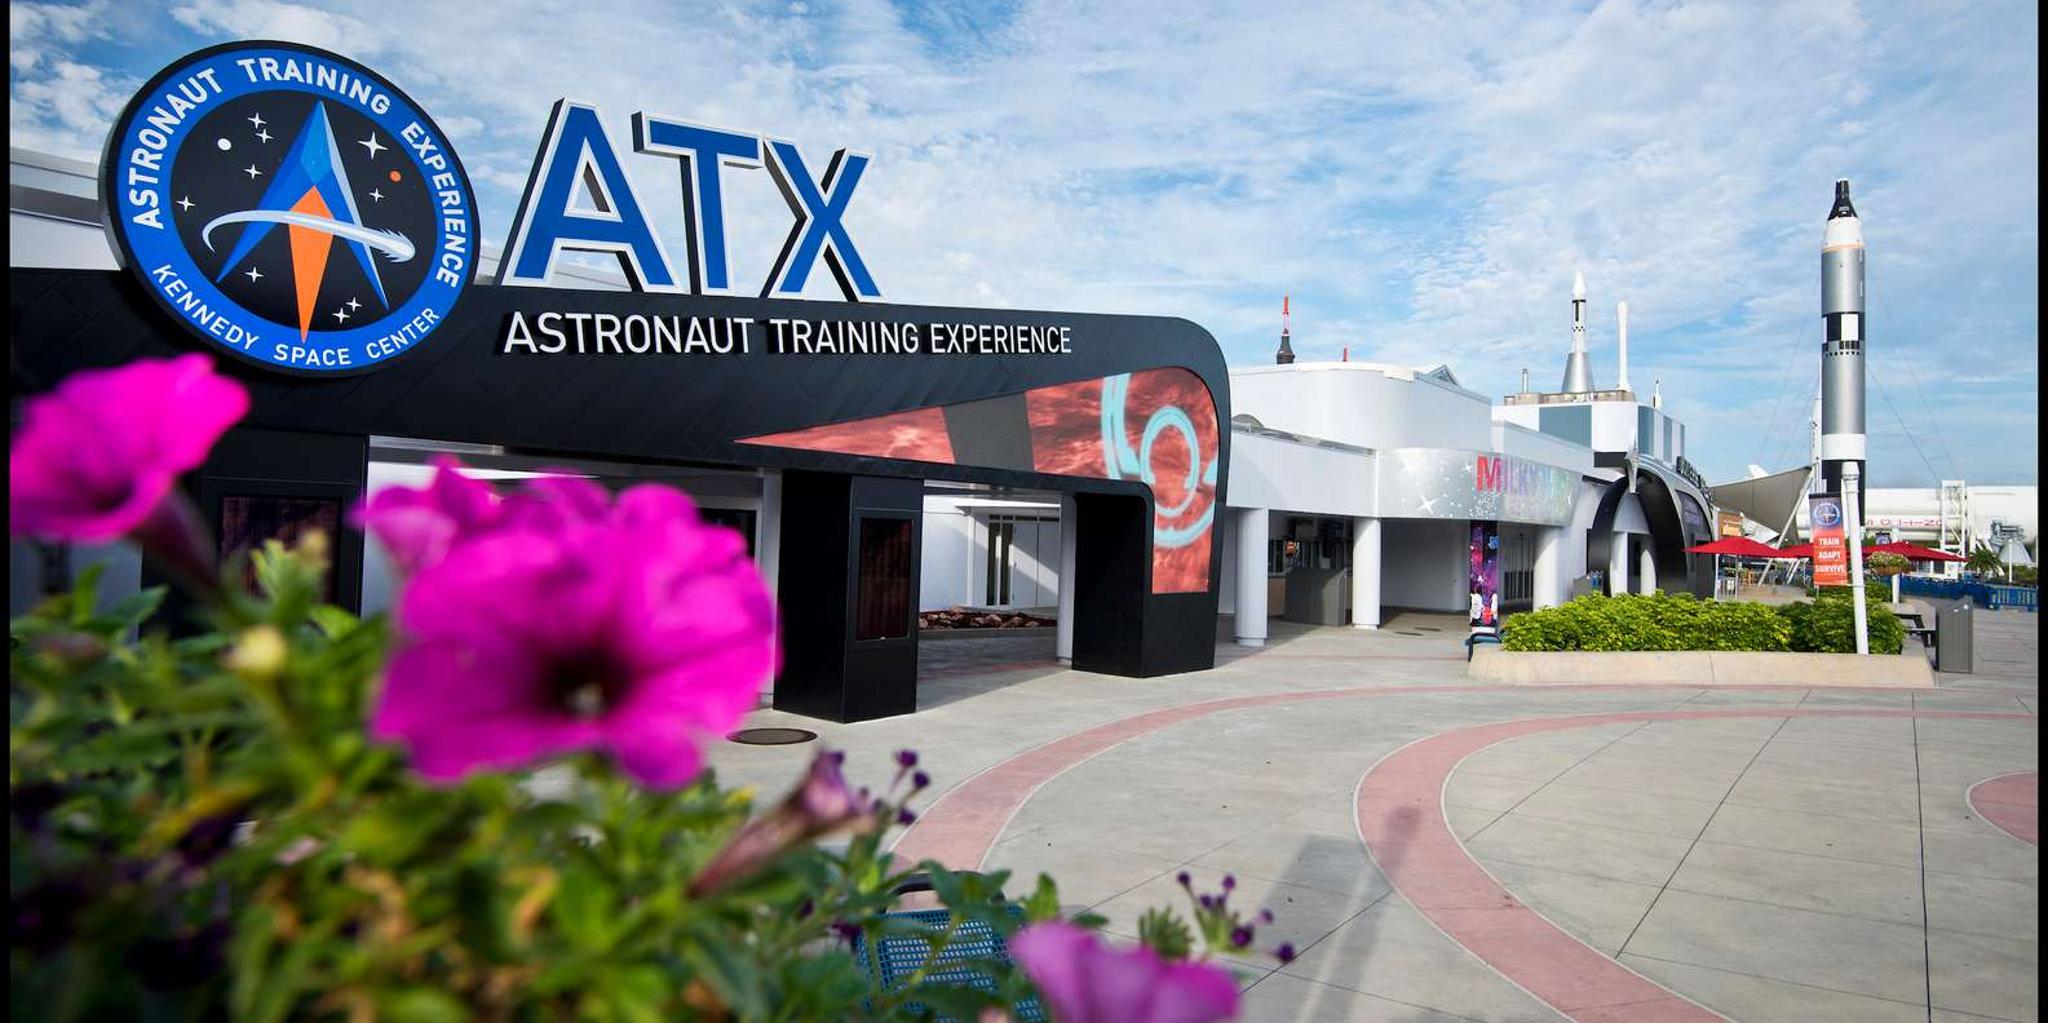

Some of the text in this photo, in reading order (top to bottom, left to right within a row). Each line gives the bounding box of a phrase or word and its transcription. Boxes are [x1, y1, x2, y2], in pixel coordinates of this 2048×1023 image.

[127, 57, 469, 288] ASTRONAUT TRAINING EXPERIENCE
[500, 98, 883, 303] ATX
[153, 264, 440, 367] KENNEDY SPACE CENTER
[503, 310, 1072, 355] ASTRONAUT TRAINING EXPERIENCE
[1818, 537, 1840, 546] TRAIN
[1818, 551, 1841, 559] ADAPT
